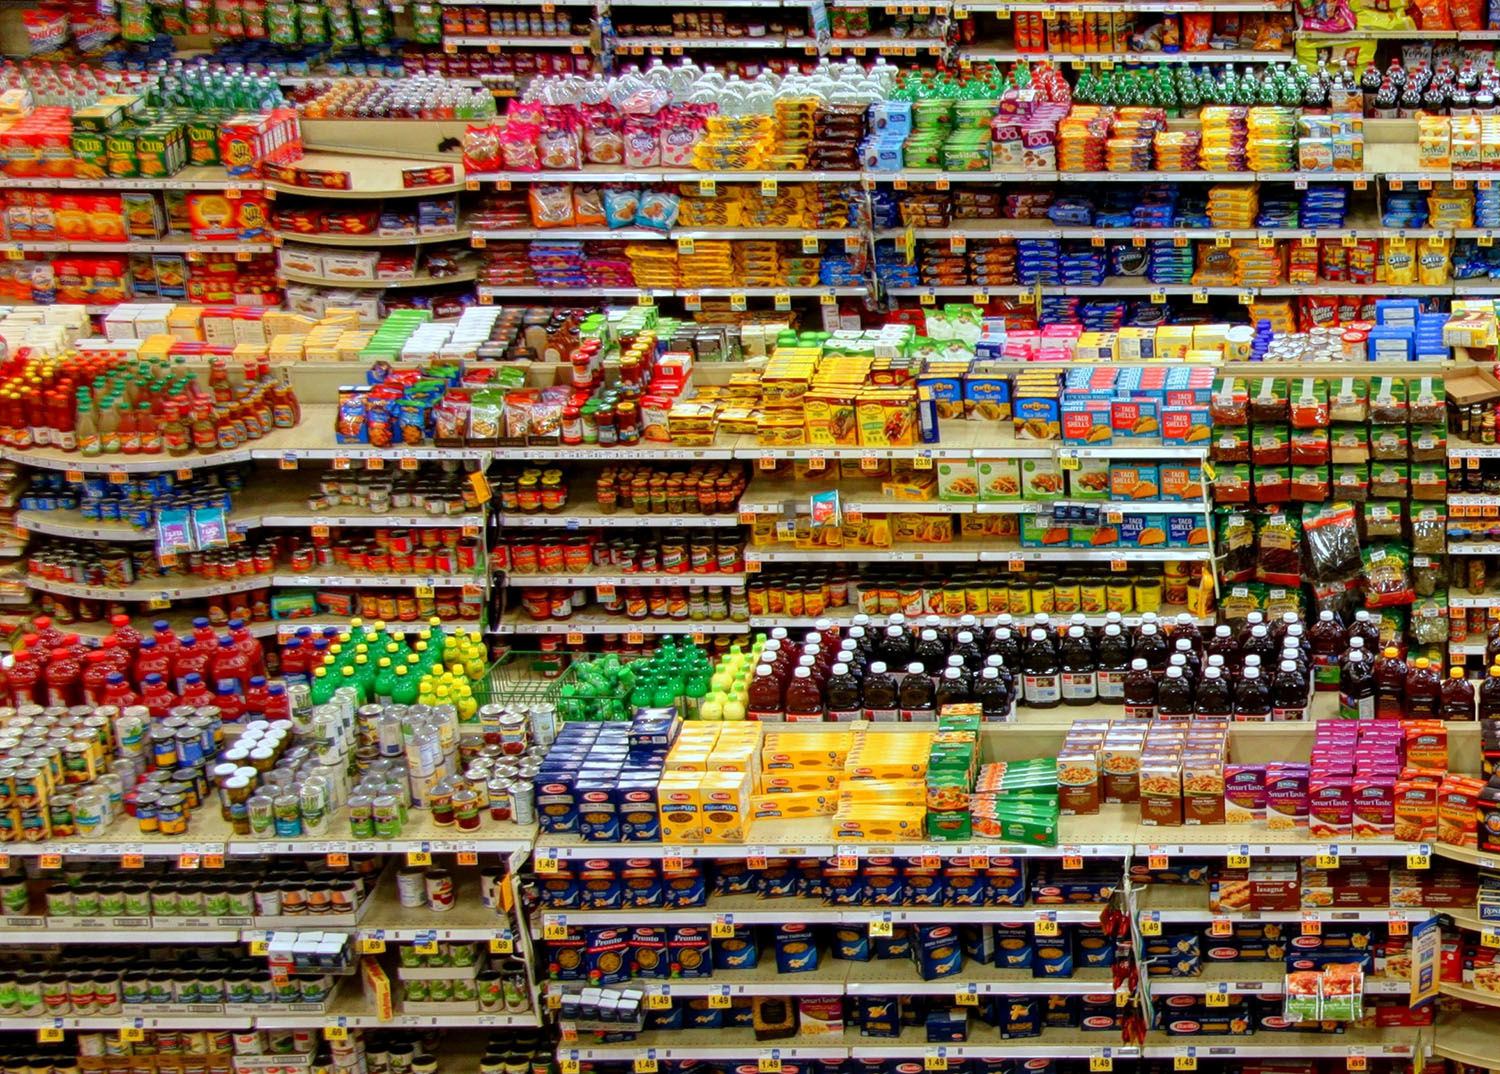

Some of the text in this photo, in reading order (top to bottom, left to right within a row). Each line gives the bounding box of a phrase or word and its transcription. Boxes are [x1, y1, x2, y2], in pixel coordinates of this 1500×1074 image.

[996, 129, 1020, 141] 100
[1028, 135, 1050, 146] 100
[665, 860, 682, 868] 2.19
[749, 859, 766, 867] 2.19
[840, 858, 857, 866] 2.19
[1151, 858, 1165, 866] 1.19
[1256, 886, 1284, 894] lasagna
[1304, 924, 1319, 932] 1.19
[595, 937, 622, 947] Pronto
[1485, 935, 1500, 944] 1.39
[370, 941, 379, 949] .69
